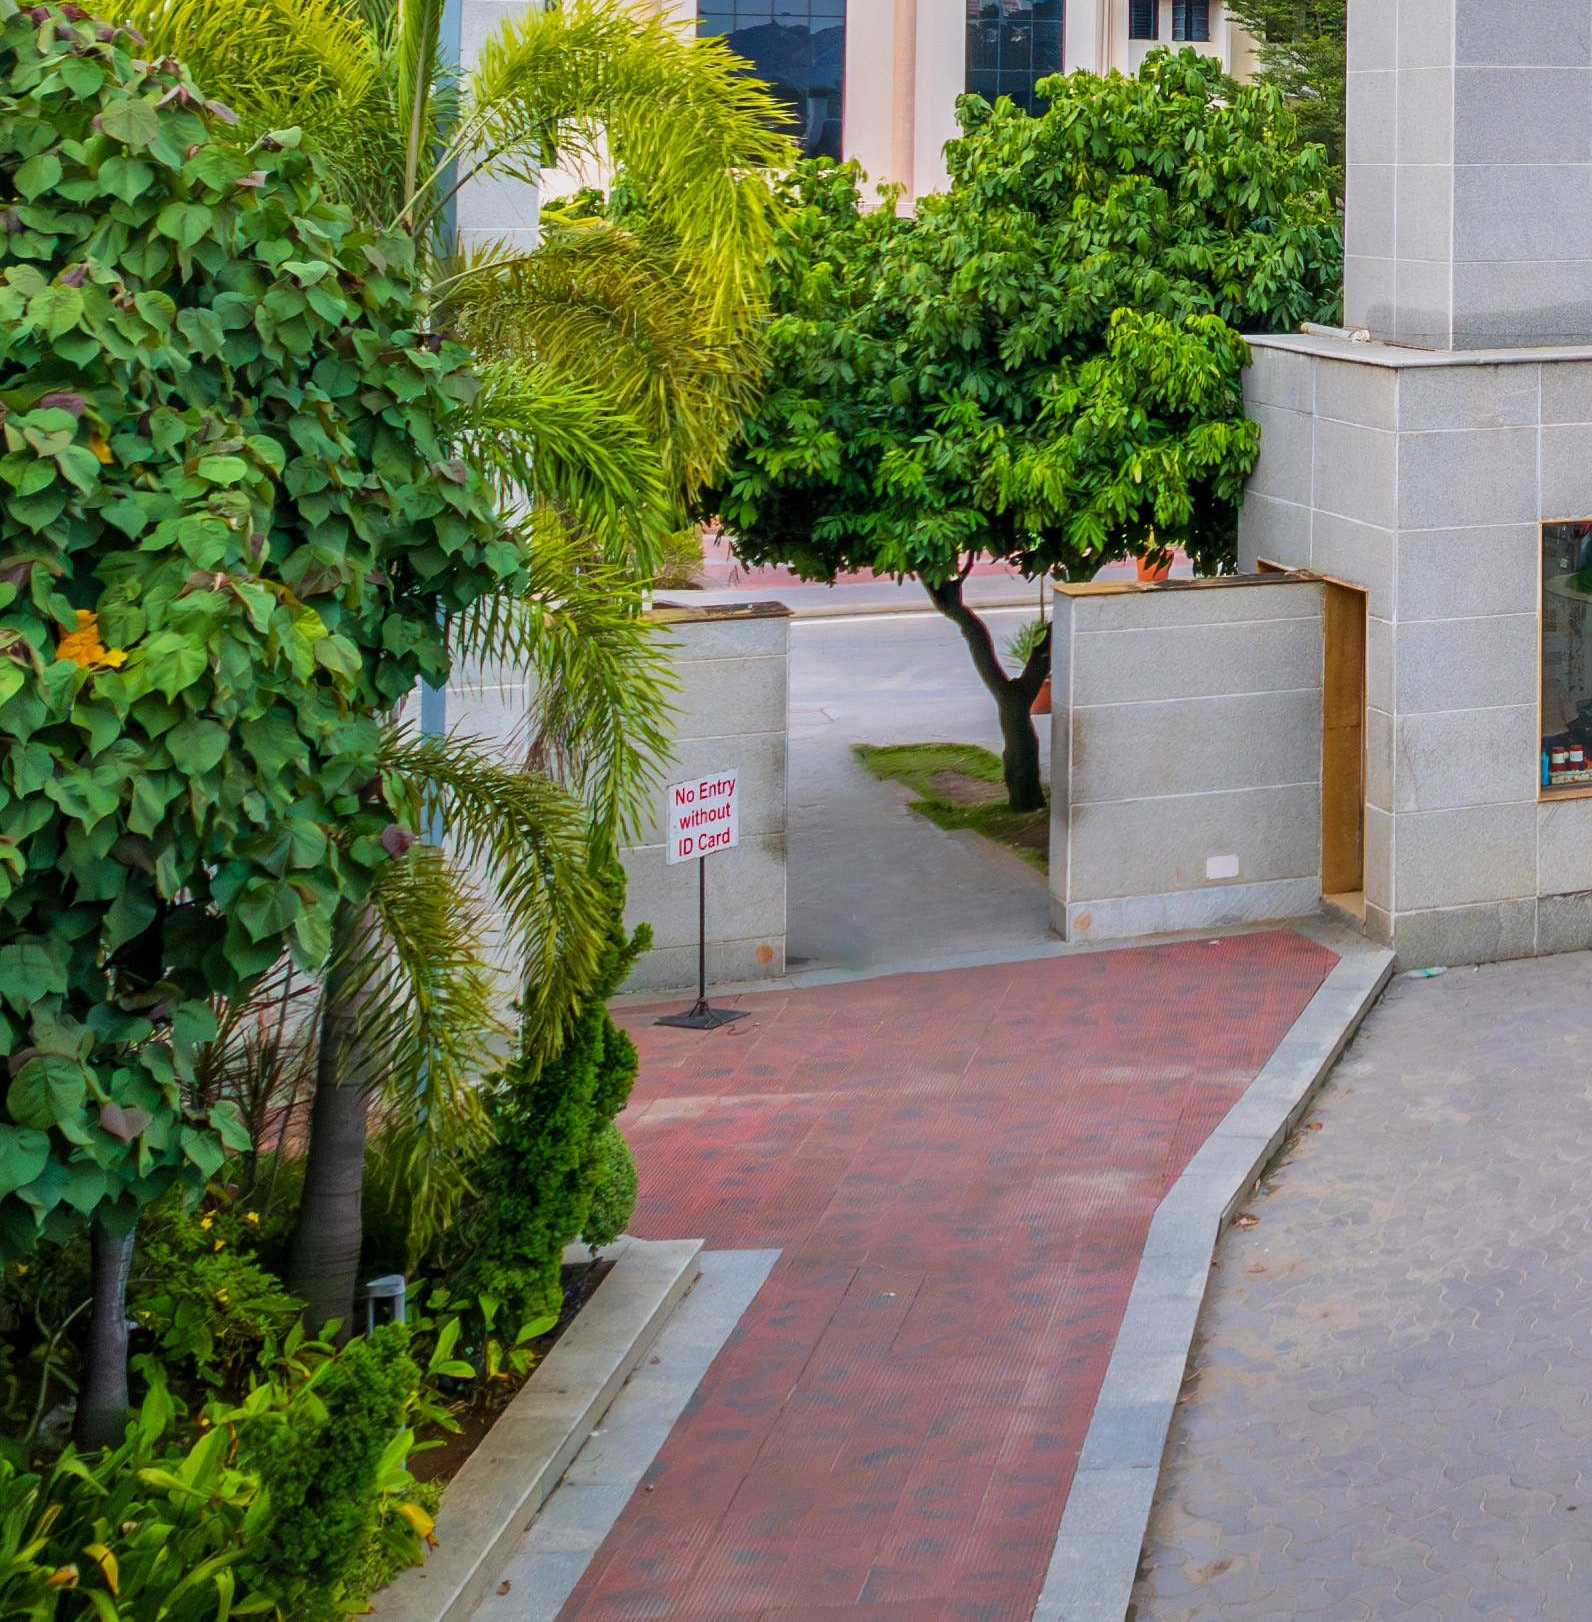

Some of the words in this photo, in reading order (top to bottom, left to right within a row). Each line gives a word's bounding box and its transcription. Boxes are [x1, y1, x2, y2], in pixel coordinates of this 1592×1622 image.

[675, 787, 695, 807] No
[699, 778, 736, 801] Entry
[679, 803, 731, 830] without
[679, 837, 693, 857] ID
[698, 827, 730, 851] Card
